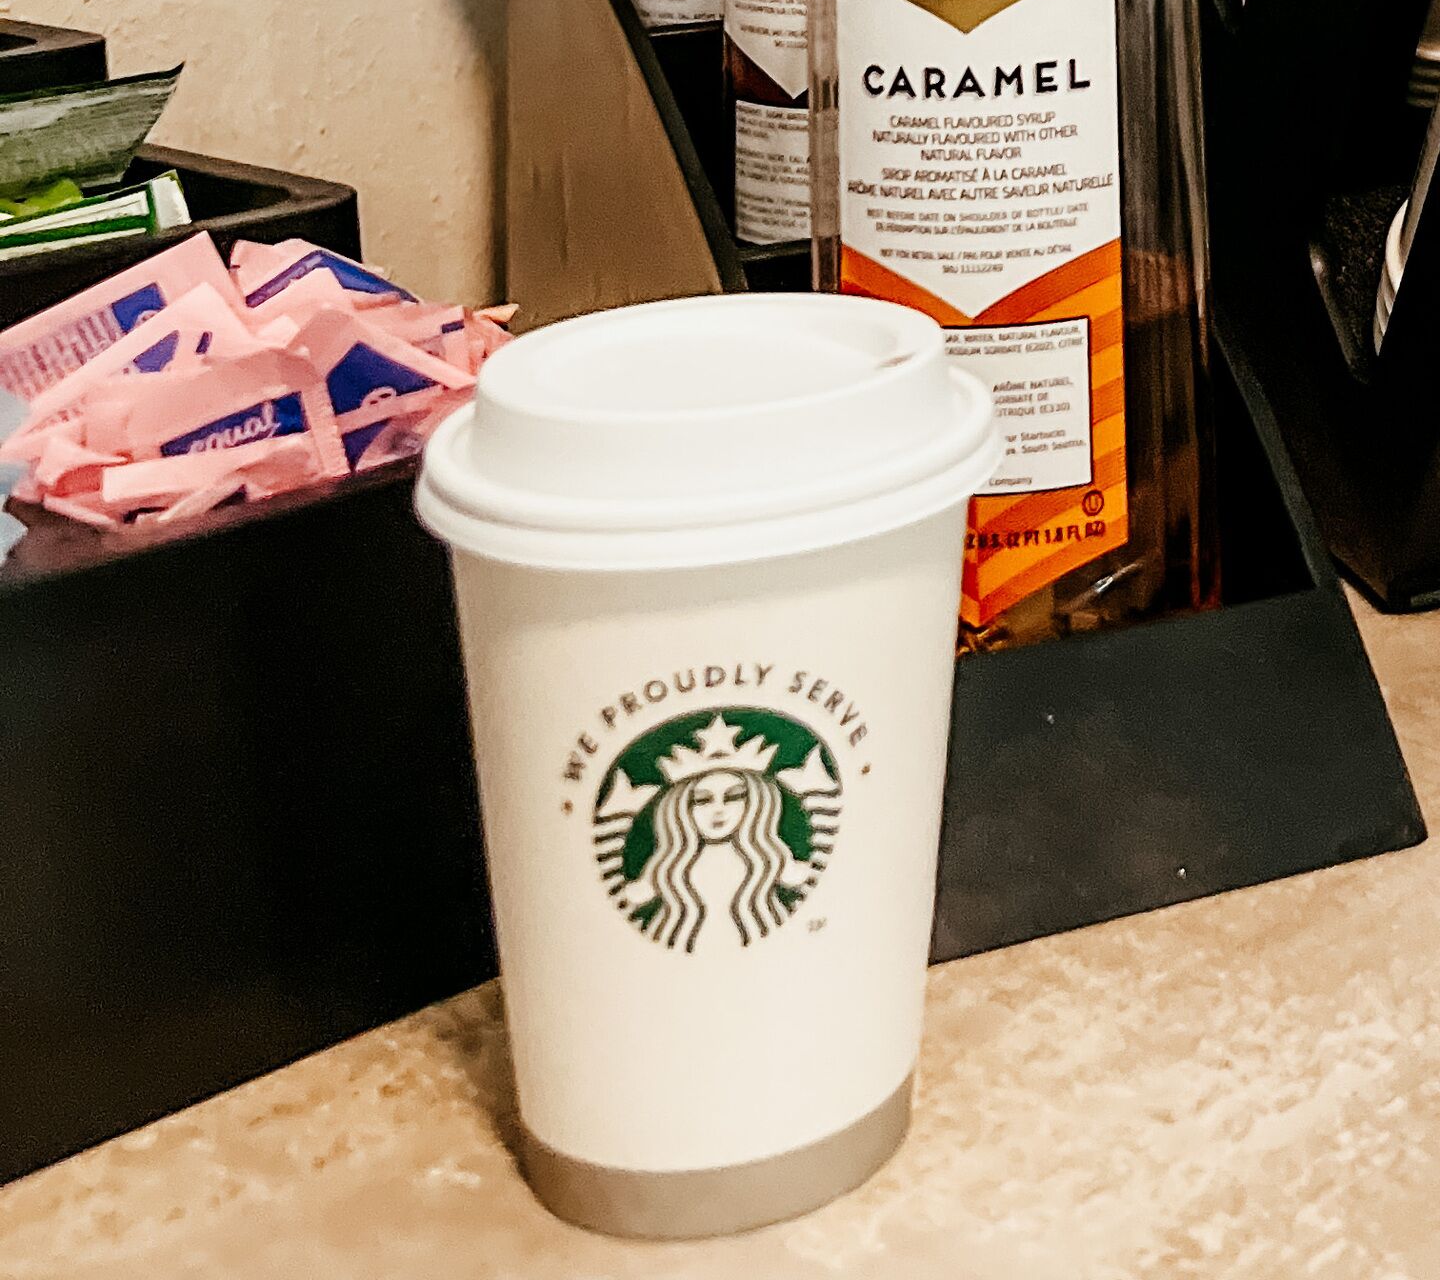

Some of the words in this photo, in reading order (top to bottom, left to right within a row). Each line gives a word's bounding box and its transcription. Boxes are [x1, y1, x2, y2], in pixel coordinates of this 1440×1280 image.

[862, 59, 1091, 99] CARAMEL
[943, 114, 1014, 129] FLAVOURED
[1016, 111, 1056, 126] SYRUP
[931, 131, 1000, 145] FLAVOURED
[1003, 129, 1036, 143] WITH
[1039, 124, 1078, 141] OTHER
[920, 148, 974, 161] NATURAL
[993, 168, 1008, 181] LA
[1011, 163, 1067, 180] CARAMEL
[927, 186, 957, 201] AVEC
[959, 186, 998, 200] AUTRE
[1002, 183, 1049, 199] SAVEUR
[1052, 173, 1114, 194] NATURELLE
[599, 661, 776, 730] PROUDLY
[786, 669, 870, 748] SERVE
